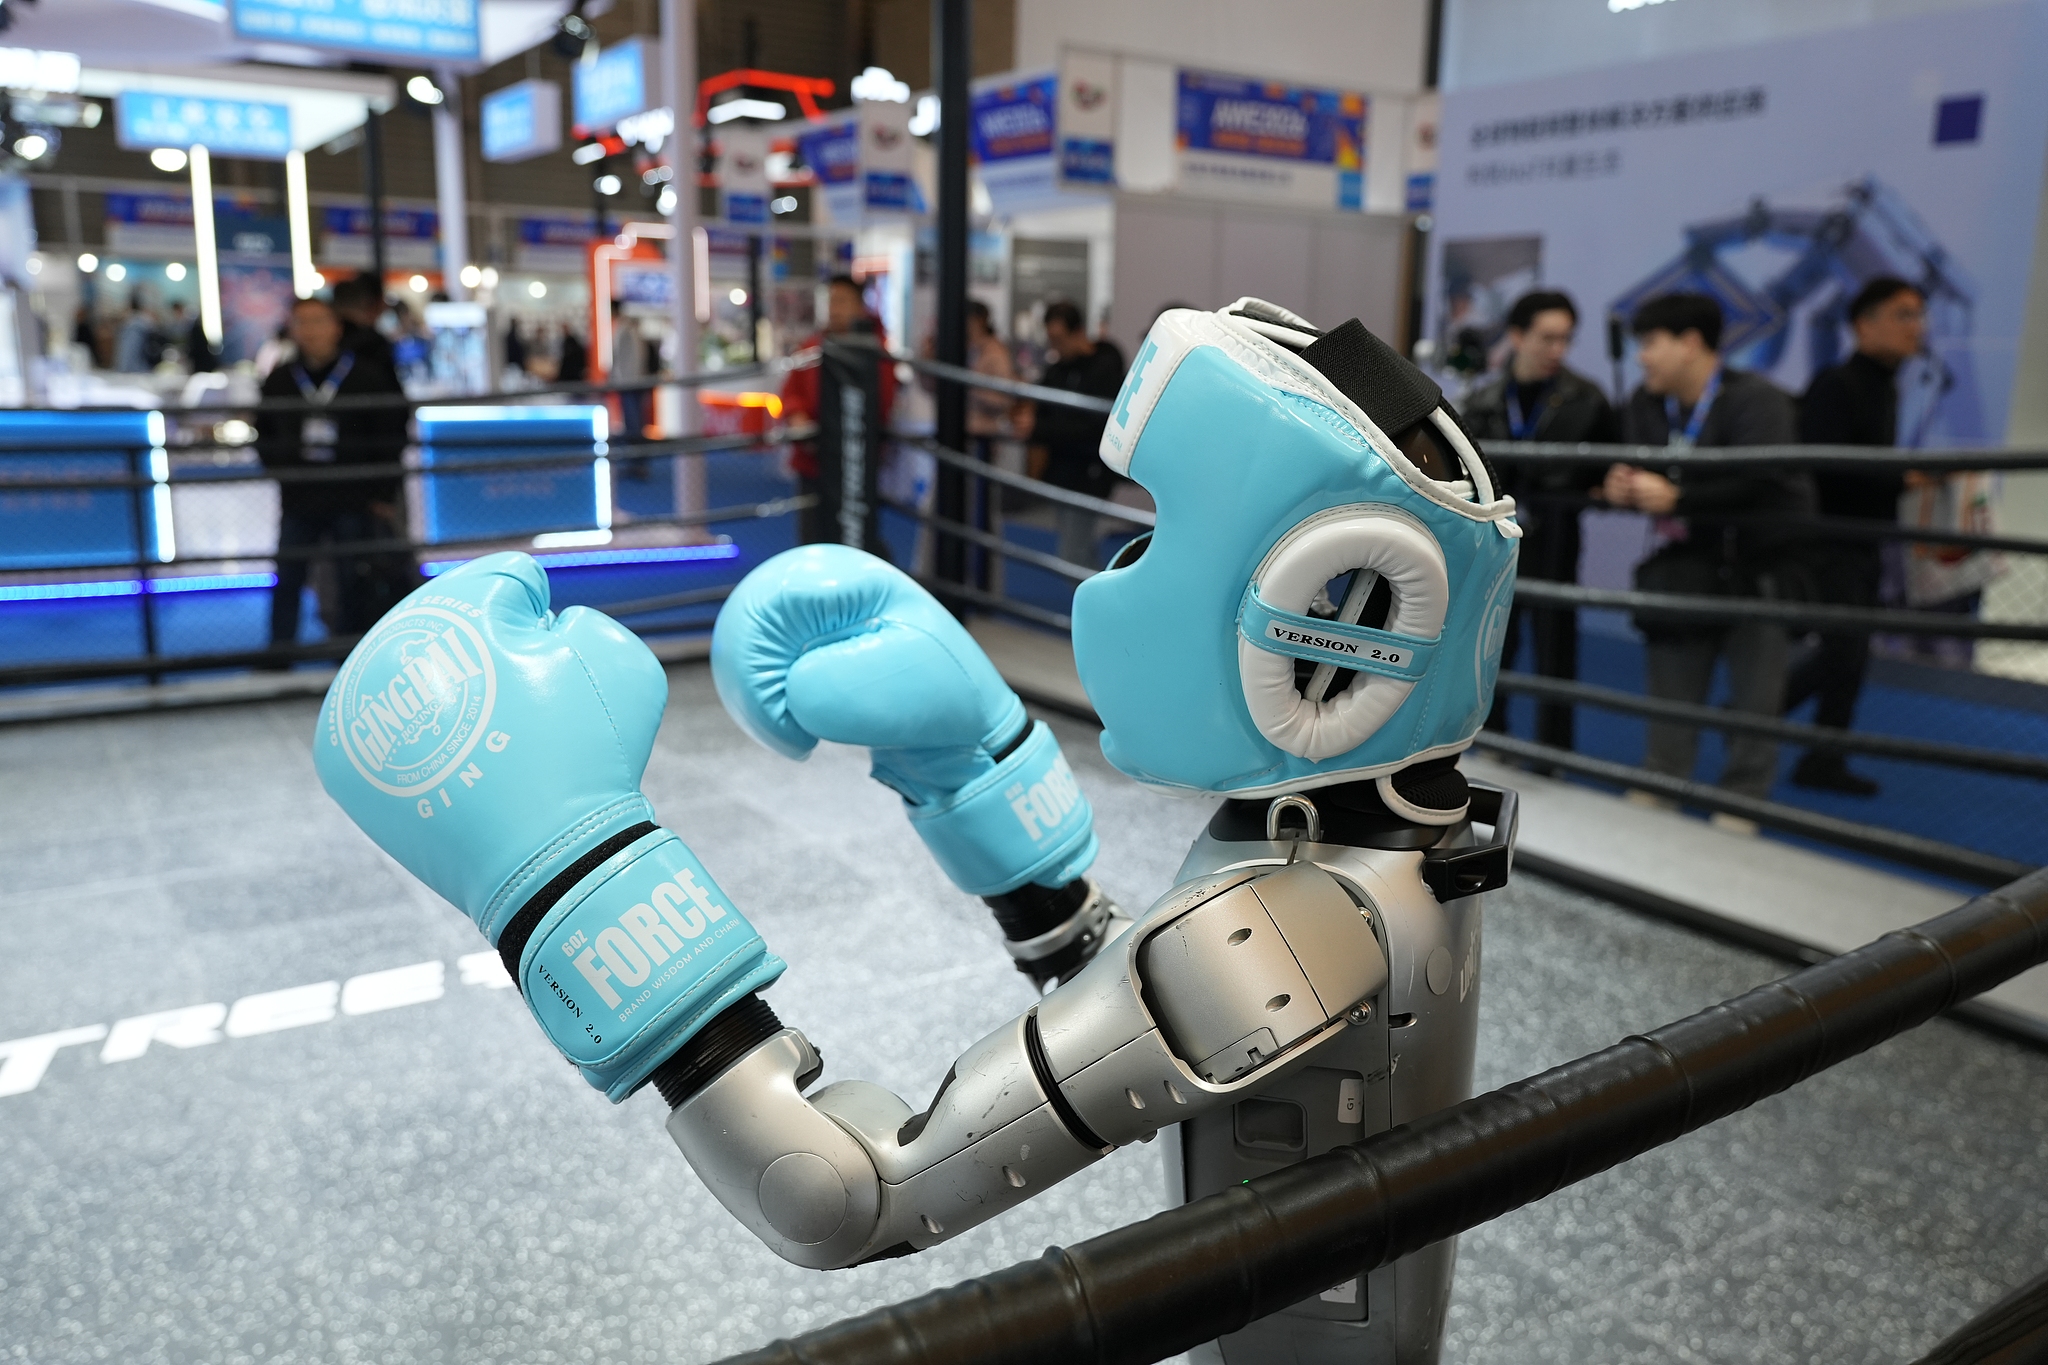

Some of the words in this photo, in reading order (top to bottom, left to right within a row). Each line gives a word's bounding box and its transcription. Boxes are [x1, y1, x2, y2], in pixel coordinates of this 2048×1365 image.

[420, 595, 484, 618] SERIES
[354, 641, 378, 671] SPORT
[377, 618, 426, 643] PRODUCTS
[1272, 626, 1359, 654] VERSION
[1370, 648, 1400, 663] 2.0
[350, 626, 484, 772] GINGPAI
[401, 701, 440, 741] BOXING
[396, 771, 421, 784] FROM
[421, 752, 449, 777] CHINA
[446, 721, 472, 755] SINCE
[466, 695, 481, 721] 2014
[571, 867, 727, 1011] FORCE
[537, 964, 584, 1019] VERSION
[585, 1023, 602, 1044] 2.0
[618, 990, 652, 1022] BRAND
[651, 953, 693, 990] WISDOM
[694, 936, 714, 957] AND
[1346, 1097, 1355, 1111] G1
